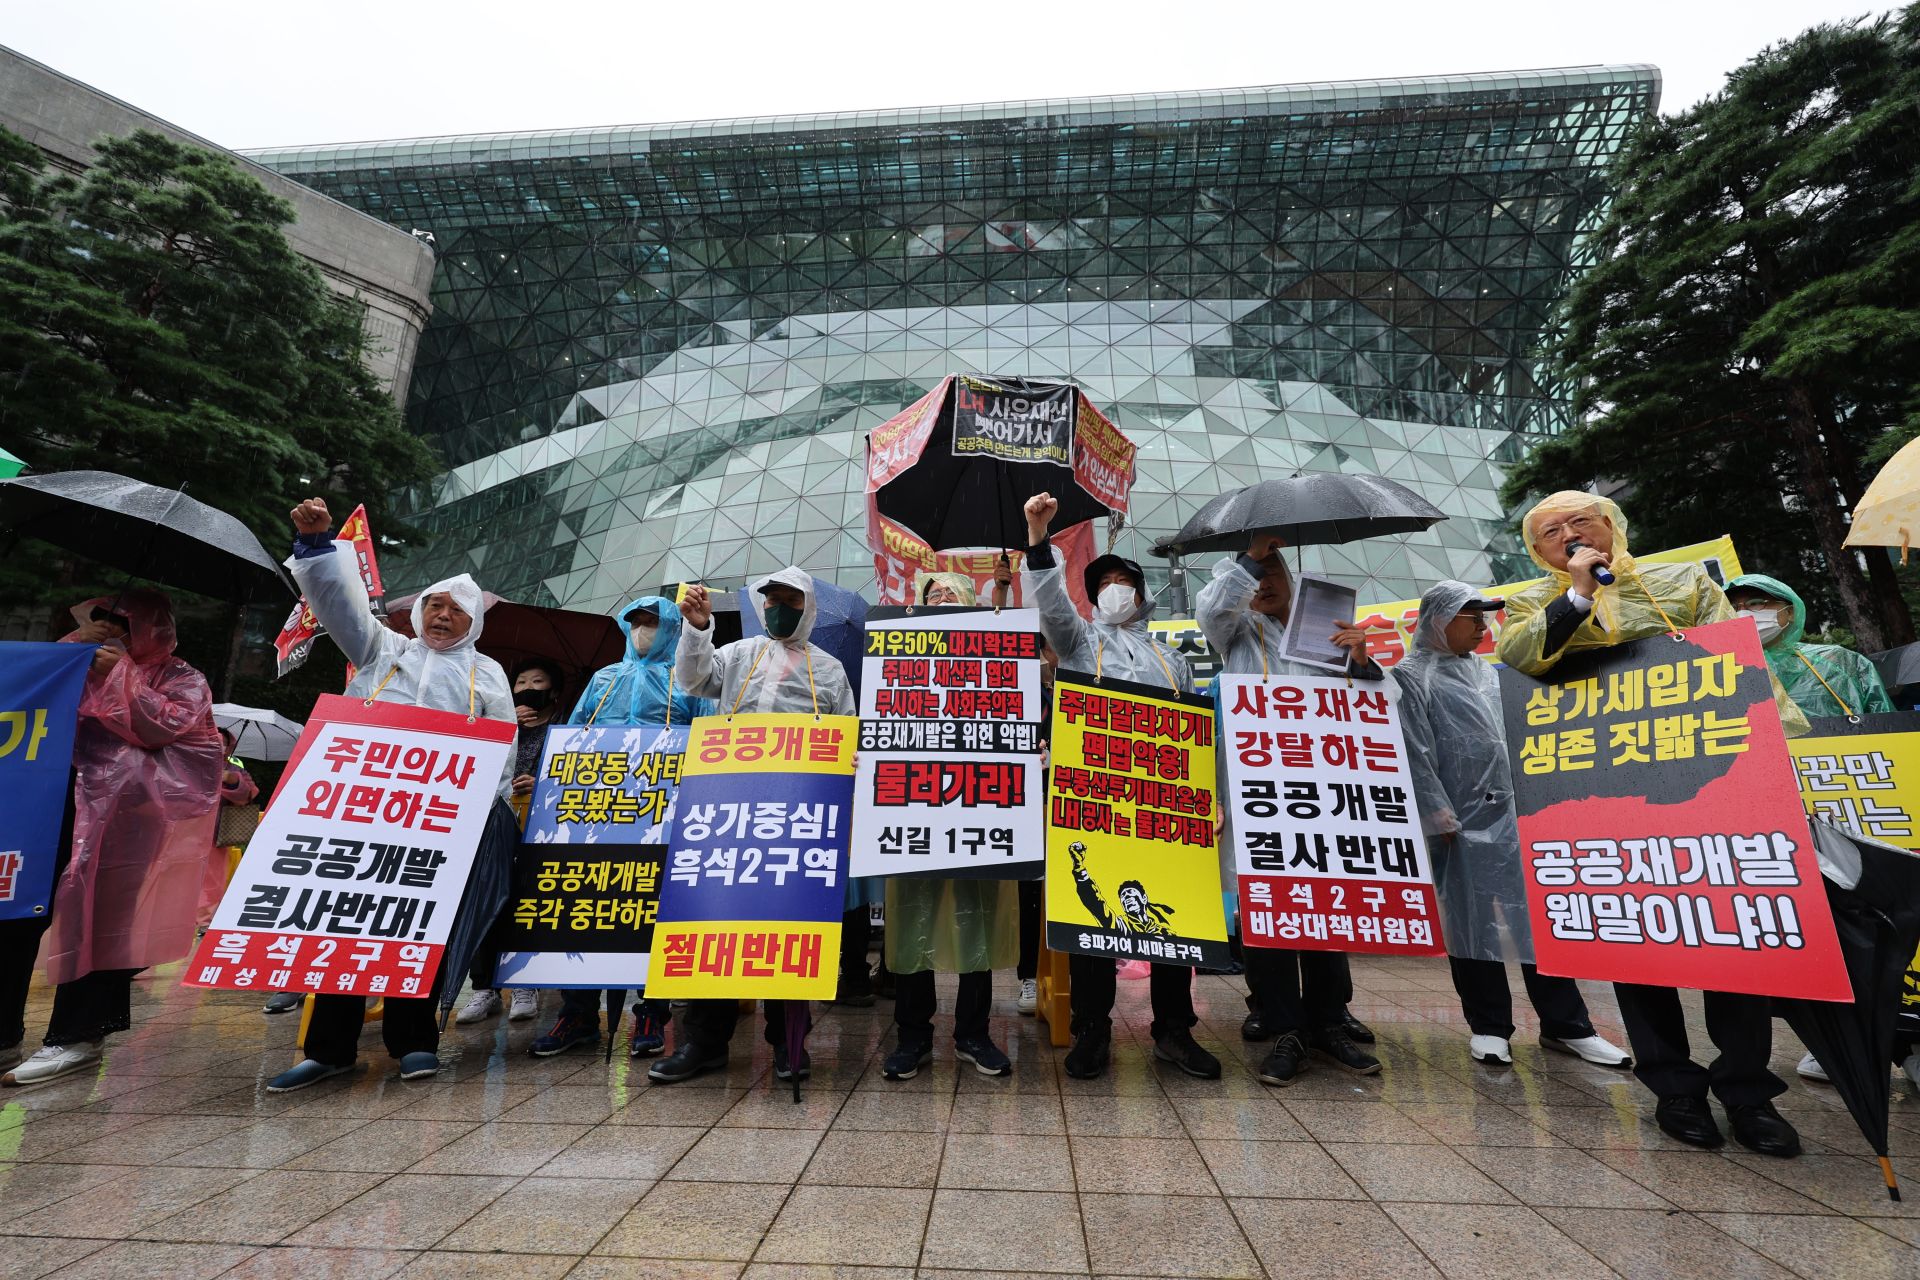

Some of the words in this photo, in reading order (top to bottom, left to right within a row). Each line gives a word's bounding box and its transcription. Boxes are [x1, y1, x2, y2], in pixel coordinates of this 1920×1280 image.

[960, 389, 985, 414] LH
[990, 397, 1068, 422] 사유재산
[994, 442, 1031, 458] 만드는게
[868, 631, 947, 656] 겨우50%
[949, 632, 1036, 657] 대지확보로
[882, 659, 930, 687] 주민의
[933, 659, 981, 688] 재산적
[986, 661, 1018, 689] 협의
[1525, 652, 1744, 727] 상가세입자
[875, 689, 940, 718] 무시하는
[943, 690, 1024, 720] 사회주의적
[1058, 688, 1212, 746] 주민갈라치기!
[1231, 684, 1390, 725] 사유재산
[700, 727, 844, 763] 공공개발
[862, 722, 956, 749] 공공재개발은
[962, 723, 994, 749] 위헌
[1000, 723, 1037, 751] 악법!
[1082, 731, 1189, 781] 편법악용!
[1235, 731, 1399, 773] 강탈하는
[1519, 727, 1596, 776] 생존
[1610, 709, 1752, 767] 짓밟는
[324, 736, 475, 790] 주민의사
[550, 753, 628, 786] 대장동
[1790, 752, 1896, 791] 꾼만
[873, 760, 1026, 808] 물러가라!
[1053, 765, 1212, 817] 부동산투기비리온상
[1241, 780, 1409, 824] 공공개발
[298, 780, 459, 833] 외면하는
[556, 789, 668, 825] 못봤는가
[682, 803, 838, 841] 상가중심!
[877, 826, 931, 855] 신길
[945, 827, 1014, 856] 1구역
[1135, 809, 1214, 848] 물러가라!
[271, 834, 448, 888] 공공개발
[670, 848, 837, 887] 흑석2구역
[1245, 831, 1420, 878] 결사반대
[1531, 832, 1801, 888] 공공재개발
[537, 861, 660, 893] 공공재개발
[236, 884, 436, 942] 결사반대!
[513, 899, 564, 931] 즉각
[1249, 911, 1434, 947] 비상대책위원회
[1546, 892, 1806, 951] 웬말이냐!!
[663, 933, 822, 978] 절대반대
[1078, 932, 1133, 954] 송파거여
[1137, 939, 1203, 961] 새마을구역
